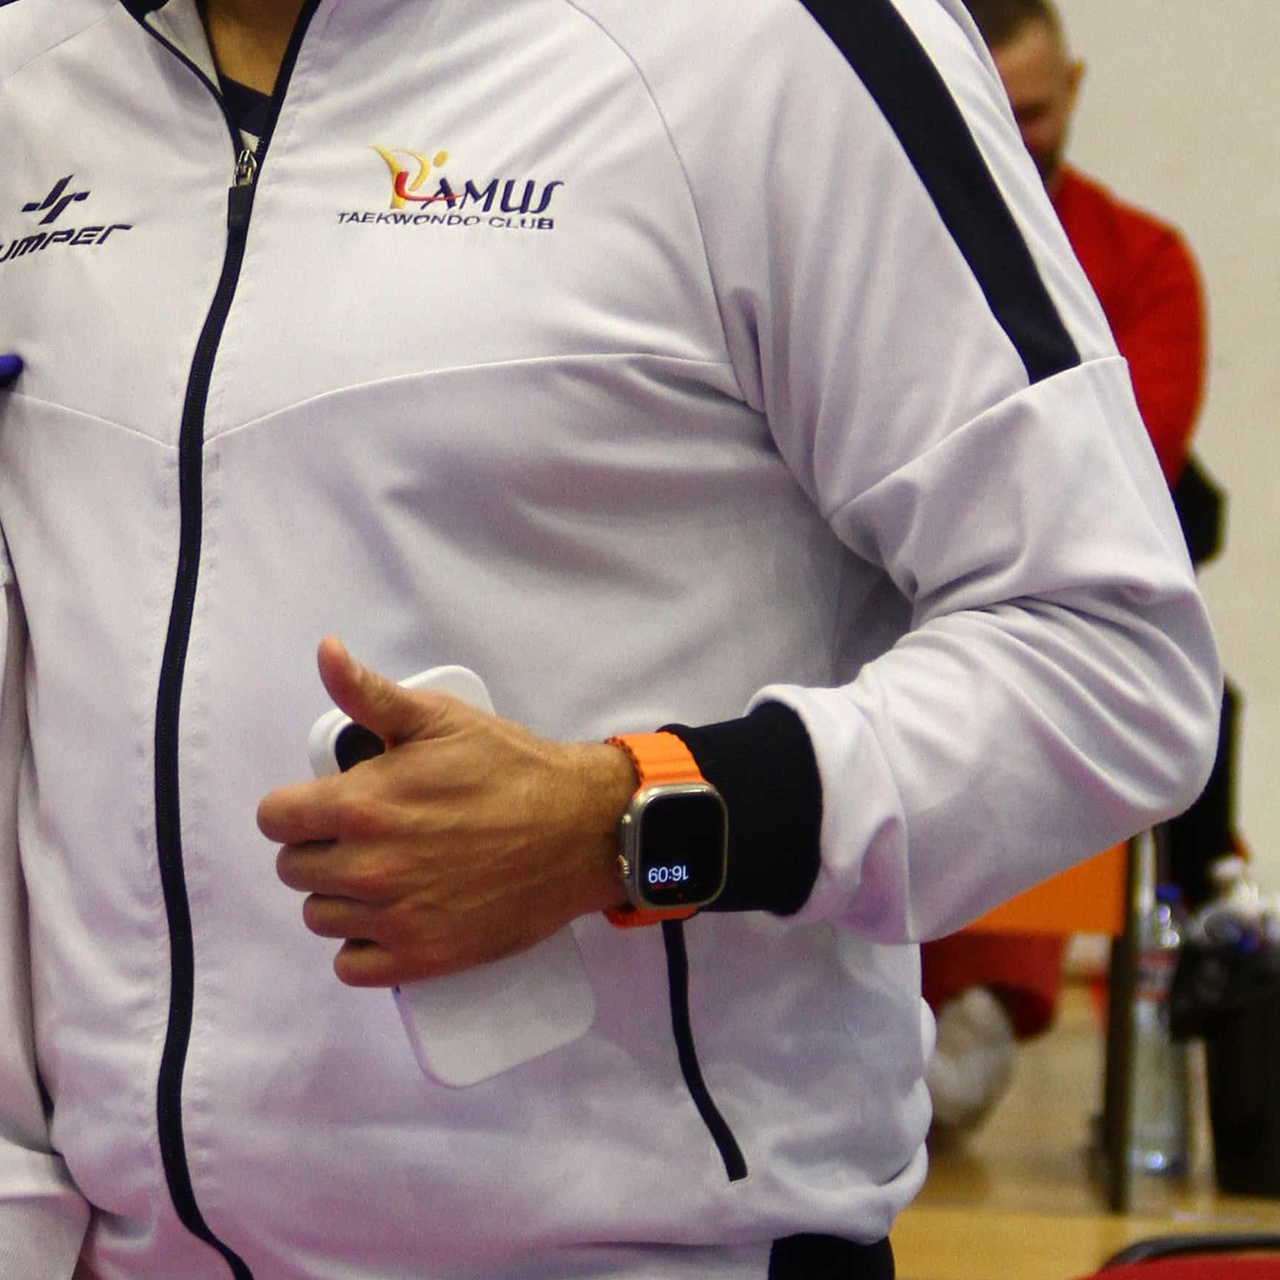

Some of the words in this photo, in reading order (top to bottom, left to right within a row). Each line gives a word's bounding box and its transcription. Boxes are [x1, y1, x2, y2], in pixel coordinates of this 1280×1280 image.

[337, 211, 481, 227] TAEKWONDO
[488, 215, 555, 231] CLUB
[647, 864, 690, 884] 16:09
